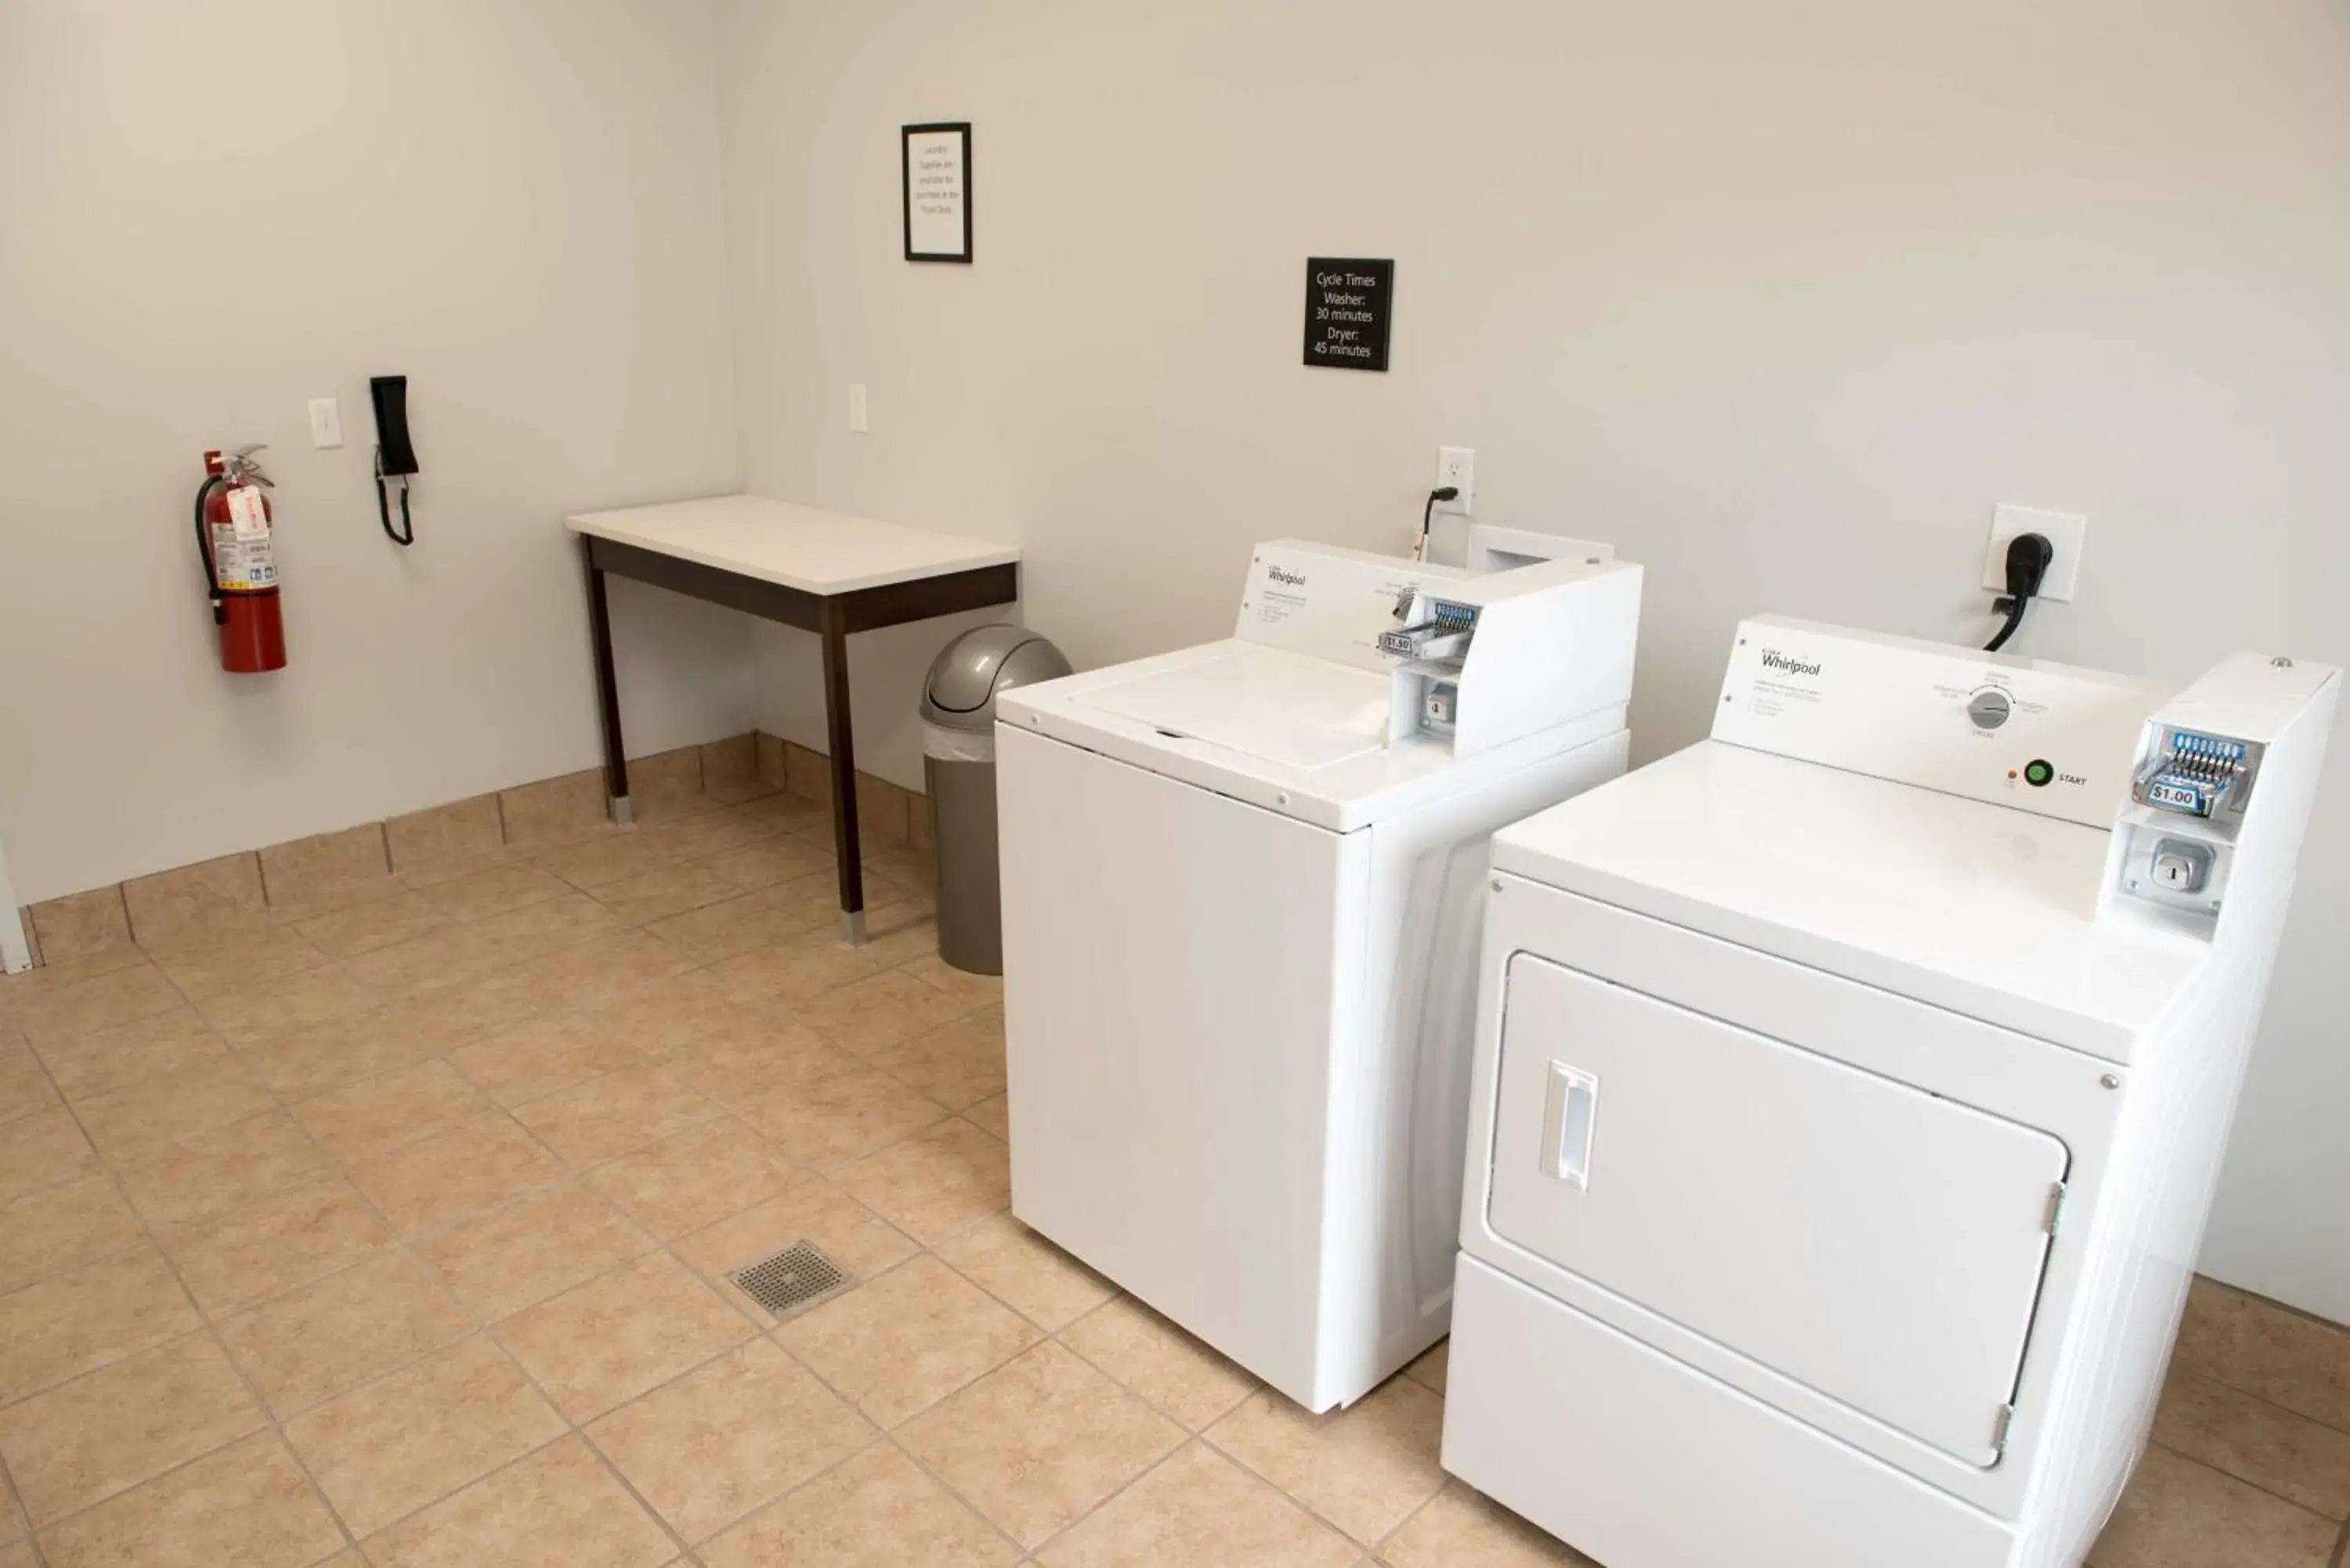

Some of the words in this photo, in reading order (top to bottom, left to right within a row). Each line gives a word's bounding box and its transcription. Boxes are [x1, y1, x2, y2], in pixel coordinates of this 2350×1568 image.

[1316, 272, 1342, 287] Cycle
[1345, 273, 1376, 287] Times
[1324, 291, 1365, 306] Washer:
[1316, 306, 1329, 320] 30
[1332, 309, 1373, 322] minutes
[1328, 327, 1359, 345] Dryer:
[1314, 341, 1328, 354] 45
[1329, 344, 1372, 357] minutes
[1267, 570, 1306, 587] Whirlpool
[1762, 652, 1821, 676] Whirlpool
[2059, 773, 2087, 786] START
[2153, 786, 2193, 804] $1.00
